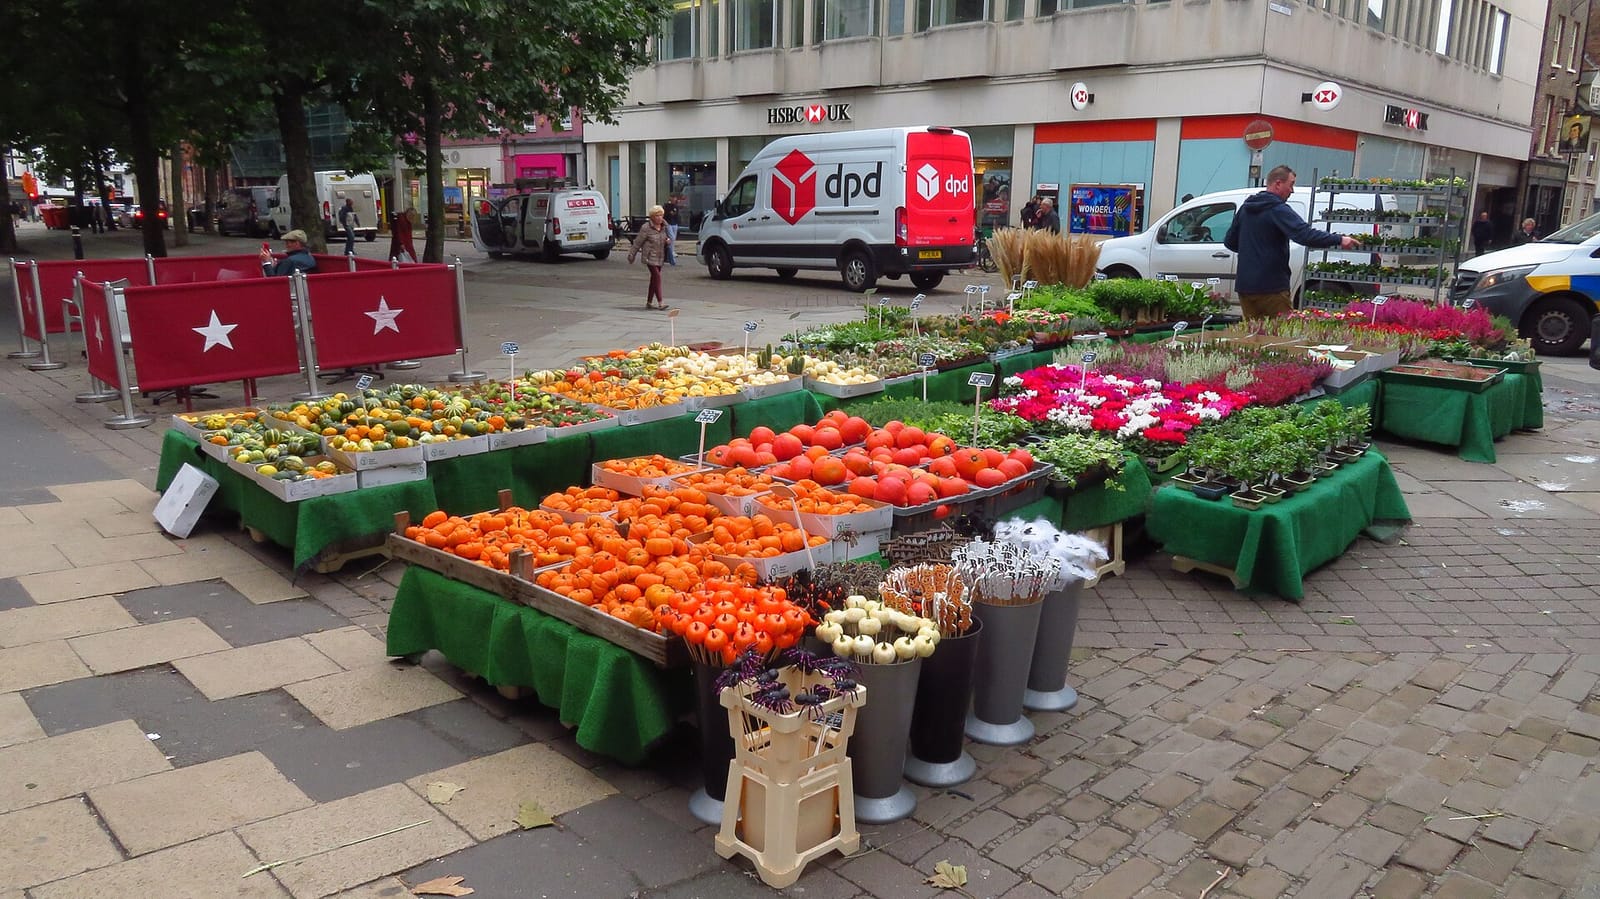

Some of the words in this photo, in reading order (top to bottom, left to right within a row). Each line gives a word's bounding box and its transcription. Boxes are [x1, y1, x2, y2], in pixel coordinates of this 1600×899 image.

[768, 106, 804, 124] HSBC
[827, 103, 851, 121] UK
[825, 161, 883, 207] dpd
[945, 174, 969, 198] dpd
[1078, 205, 1123, 214] WONDERLAB
